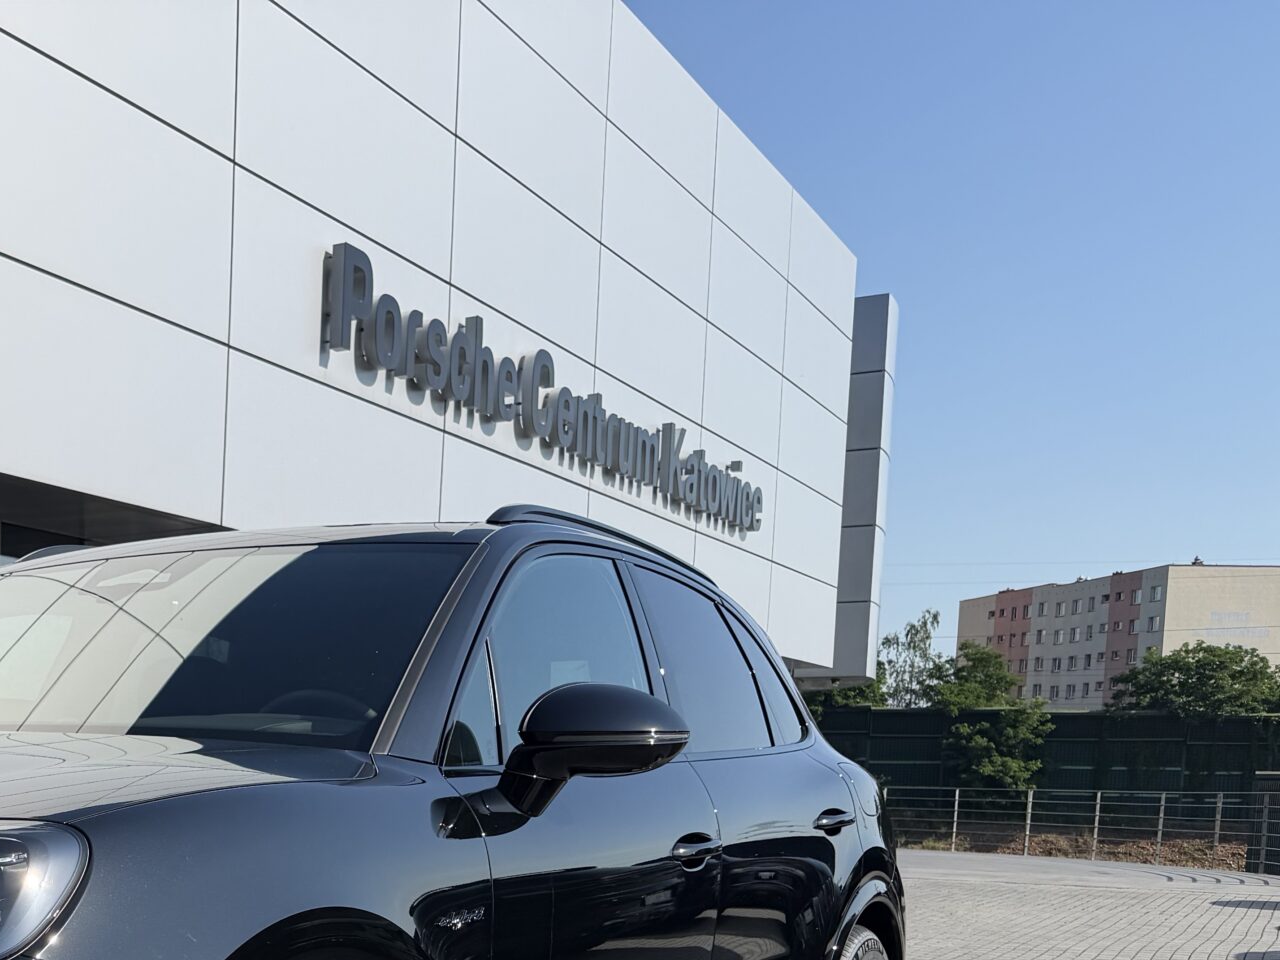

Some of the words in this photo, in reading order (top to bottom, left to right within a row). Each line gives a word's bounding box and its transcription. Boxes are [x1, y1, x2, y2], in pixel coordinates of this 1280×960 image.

[331, 242, 517, 421] Porsche
[521, 349, 659, 487] Centrum
[660, 423, 762, 532] Katowice
